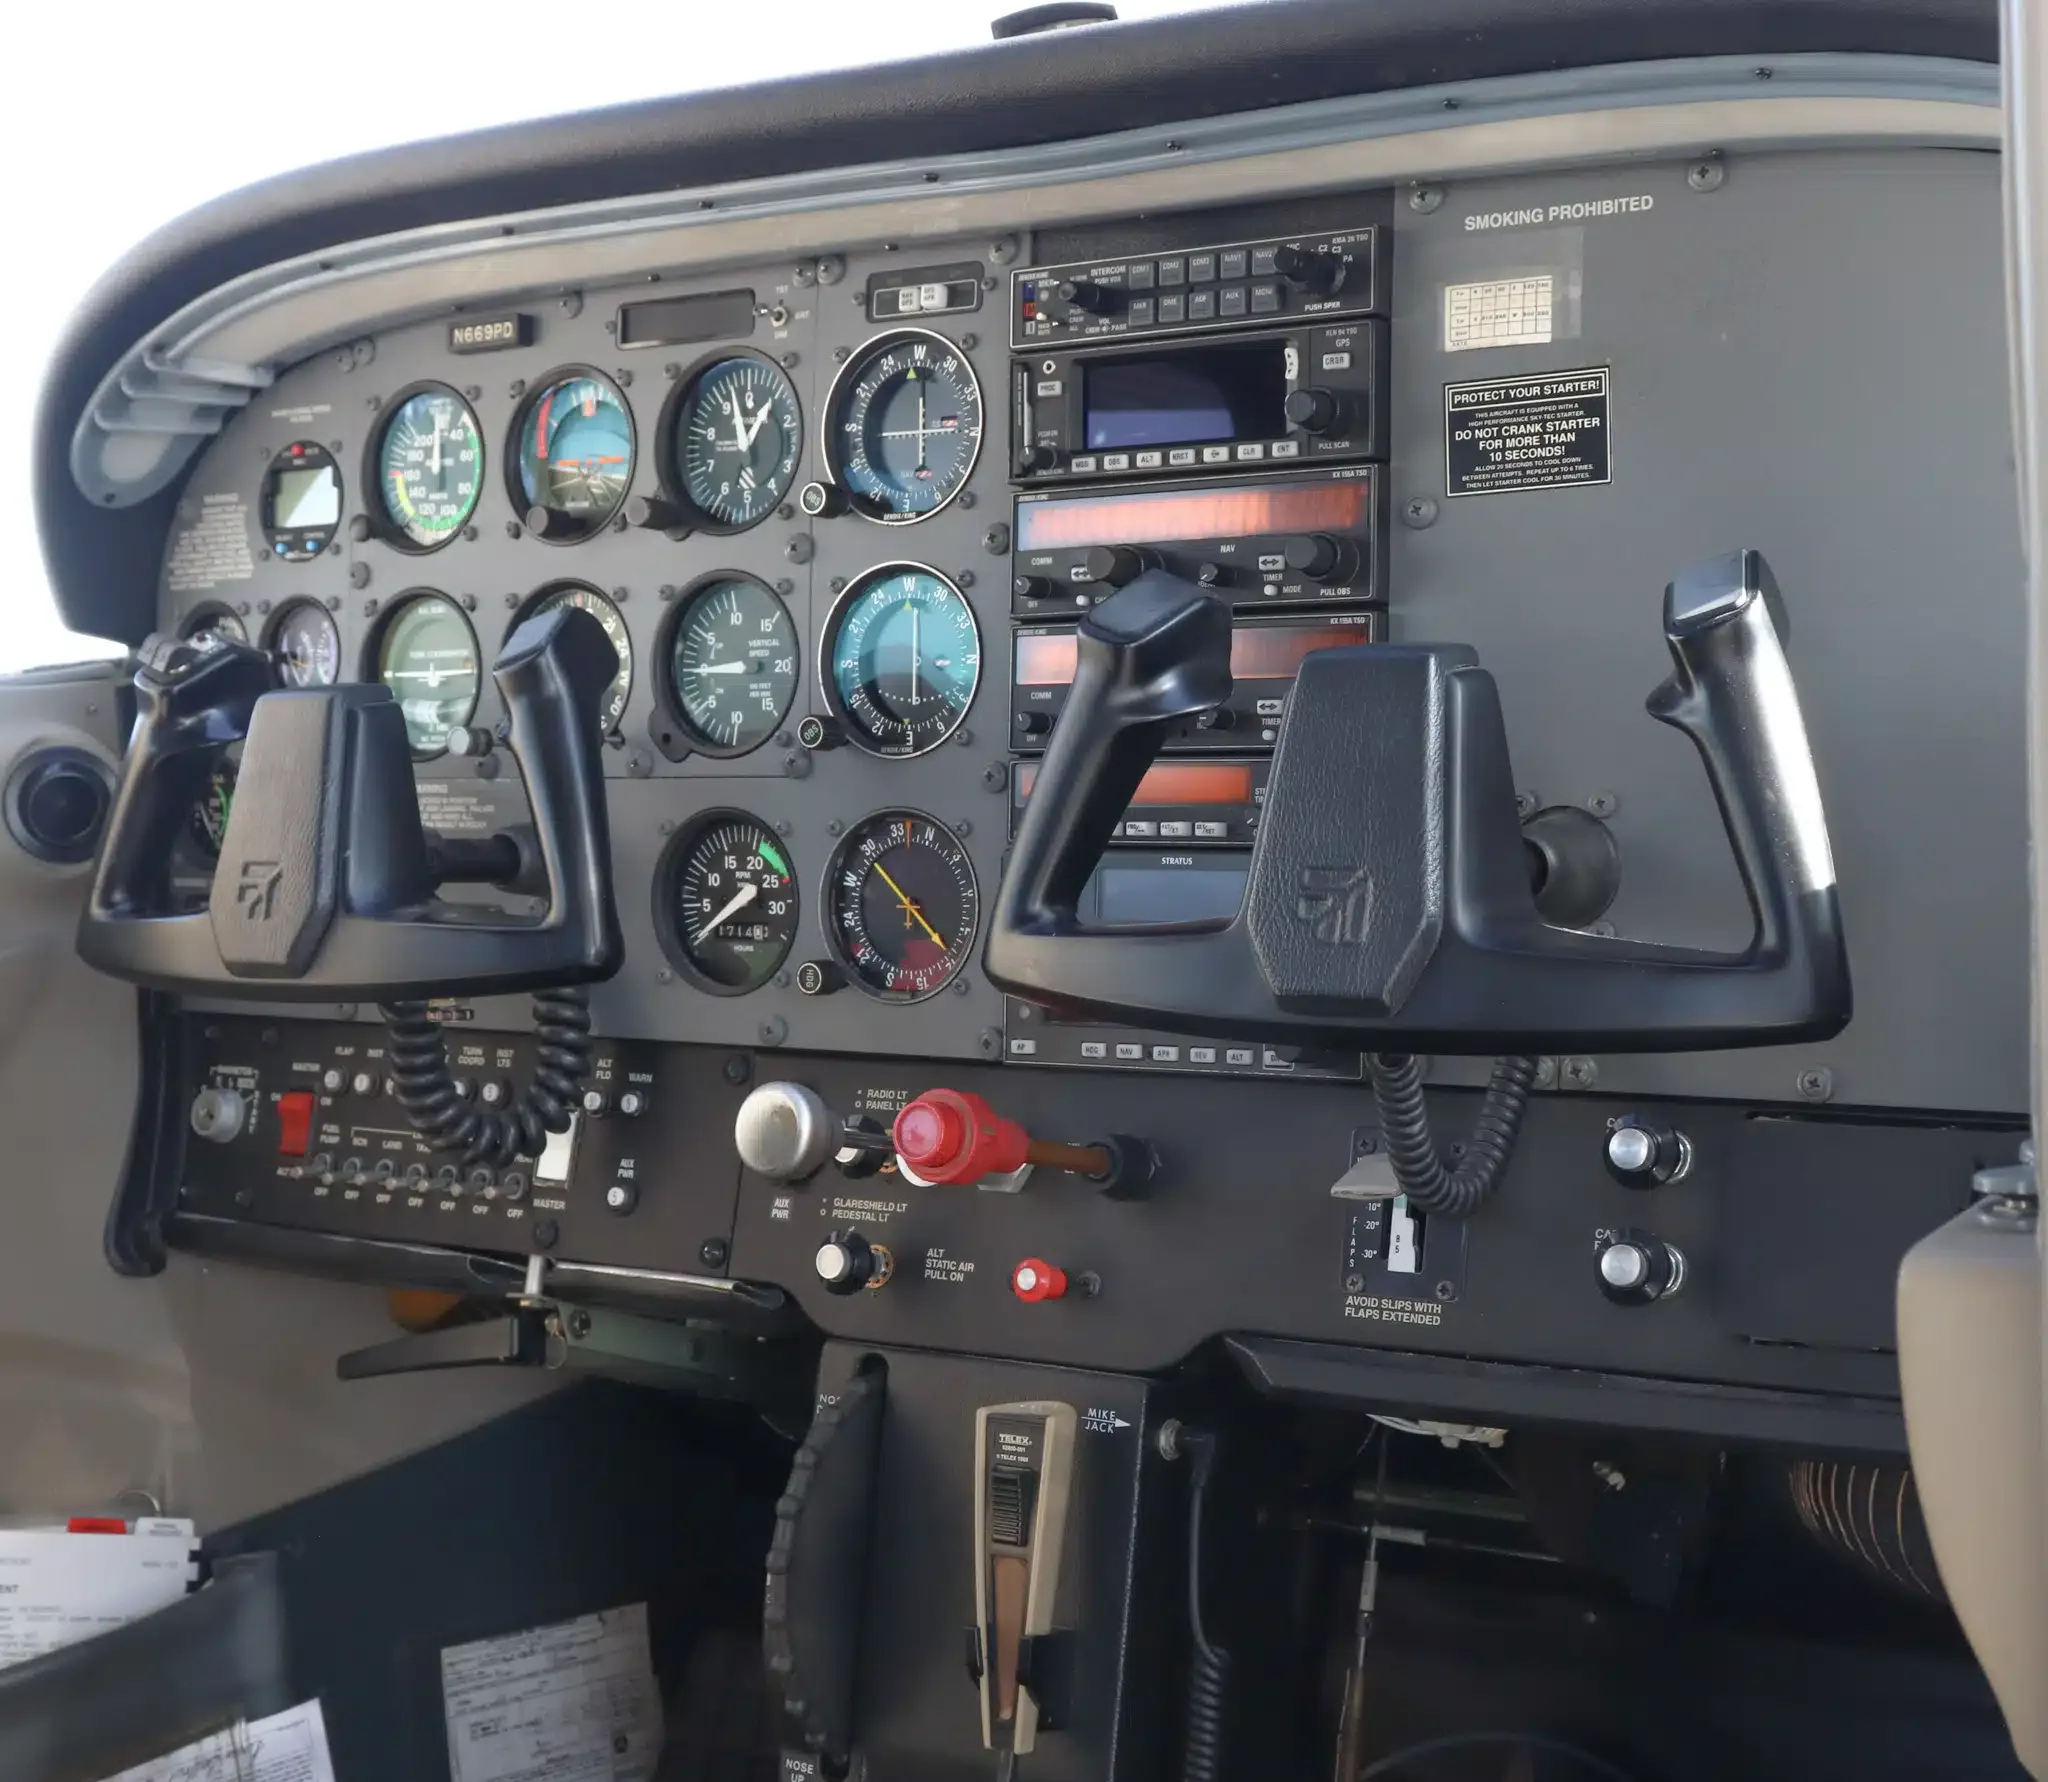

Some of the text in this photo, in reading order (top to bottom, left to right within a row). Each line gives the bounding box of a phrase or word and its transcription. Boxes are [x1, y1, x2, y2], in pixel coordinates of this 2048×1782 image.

[1465, 195, 1653, 231] SMOKING PROHIBITED
[1224, 252, 1241, 262] NAV1
[1342, 255, 1353, 263] PA
[1091, 265, 1126, 276] INTERCOM
[1226, 292, 1239, 300] AUX
[1305, 301, 1341, 311] PUSH SPKR
[453, 321, 512, 344] N669PD
[1335, 338, 1350, 347] GPS
[914, 345, 927, 360] W
[881, 355, 895, 371] 24
[943, 356, 957, 372] 30
[856, 383, 869, 398] 21
[964, 384, 977, 401] 33
[1454, 380, 1600, 404] PROTECT YOUR STARTER!
[722, 401, 732, 414] 9
[1489, 409, 1518, 417] AIRCRAFT
[1527, 405, 1556, 414] EQUIPPED
[783, 414, 792, 428] 2
[1484, 416, 1529, 426] PERFORMANCE
[707, 427, 715, 440] 8
[845, 423, 857, 433] S
[1455, 417, 1600, 440] DO NOT CRANK STARTER
[450, 429, 464, 441] 40
[1479, 432, 1575, 450] FOR MORE THAN
[1318, 442, 1332, 450] PULL
[460, 451, 474, 462] 60
[1489, 446, 1565, 462] 10 SECONDS!
[707, 459, 715, 472] 7
[783, 459, 791, 473] 3
[1475, 464, 1496, 472] ALLOW
[1504, 461, 1533, 469] SECONDS
[767, 477, 776, 490] 4
[1462, 473, 1490, 482] BETWEEN
[1466, 481, 1482, 489] THEN
[1495, 478, 1522, 486] STARTER
[1522, 476, 1540, 484] COOL
[409, 486, 426, 498] 140
[721, 482, 729, 495] 6
[744, 491, 752, 504] 5
[419, 503, 436, 514] 120
[440, 505, 457, 515] 100
[1220, 545, 1235, 553] NAV
[903, 577, 916, 592] W
[1283, 585, 1302, 593] MODE
[871, 589, 885, 605] 24
[934, 586, 949, 601] 30
[1320, 588, 1335, 596] PULL
[730, 612, 742, 625] 10
[760, 618, 772, 632] 15
[956, 614, 970, 629] 33
[848, 618, 861, 634] 21
[707, 632, 715, 646] 5
[748, 638, 780, 647] VERTICAL
[749, 649, 770, 658] SPEED
[966, 654, 977, 664] N
[774, 659, 790, 673] 20
[841, 660, 853, 668] S
[708, 695, 716, 708] 5
[1030, 691, 1052, 700] COMM
[761, 698, 773, 711] 15
[731, 711, 743, 724] 10
[804, 724, 819, 741] OBS
[906, 731, 913, 746] E
[890, 823, 905, 837] 33
[925, 826, 935, 842] N
[861, 838, 876, 856] 30
[724, 855, 737, 870] 15
[747, 856, 764, 870] 20
[1161, 857, 1192, 865] STRATUS
[708, 873, 720, 886] 10
[735, 871, 751, 879] RPM
[844, 870, 859, 887] W
[762, 875, 778, 889] 25
[703, 898, 711, 912] 5
[768, 901, 785, 914] 30
[844, 912, 855, 928] 24
[733, 944, 754, 952] HOURS
[856, 947, 870, 965] 21
[885, 972, 895, 988] S
[916, 977, 930, 991] 15
[598, 1059, 612, 1068] ALT
[596, 1071, 612, 1080] FLD
[629, 1073, 653, 1083] WARN
[867, 1089, 908, 1100] RADIO LT
[866, 1101, 894, 1111] PANEL
[322, 1124, 340, 1133] FUEL
[620, 1159, 635, 1168] AUX
[617, 1169, 634, 1178] PWR
[533, 1198, 566, 1210] MASTER
[774, 1198, 790, 1208] AUX
[834, 1198, 908, 1212] GLARESHIELD LT
[472, 1205, 489, 1215] OFF
[771, 1208, 789, 1219] PWR
[832, 1209, 890, 1223] PEDESTAL LT
[927, 1249, 945, 1258] ALT
[925, 1259, 975, 1272] STATIC AIR
[924, 1270, 964, 1282] PULL ON
[1346, 1296, 1442, 1314] AVOID SLIPS WITH
[1345, 1307, 1441, 1326] FLAPS EXTENDED
[1088, 1408, 1115, 1420] MIKE
[1085, 1421, 1113, 1433] JACK
[786, 1758, 813, 1774] NOSE
[791, 1773, 804, 1782] UP
